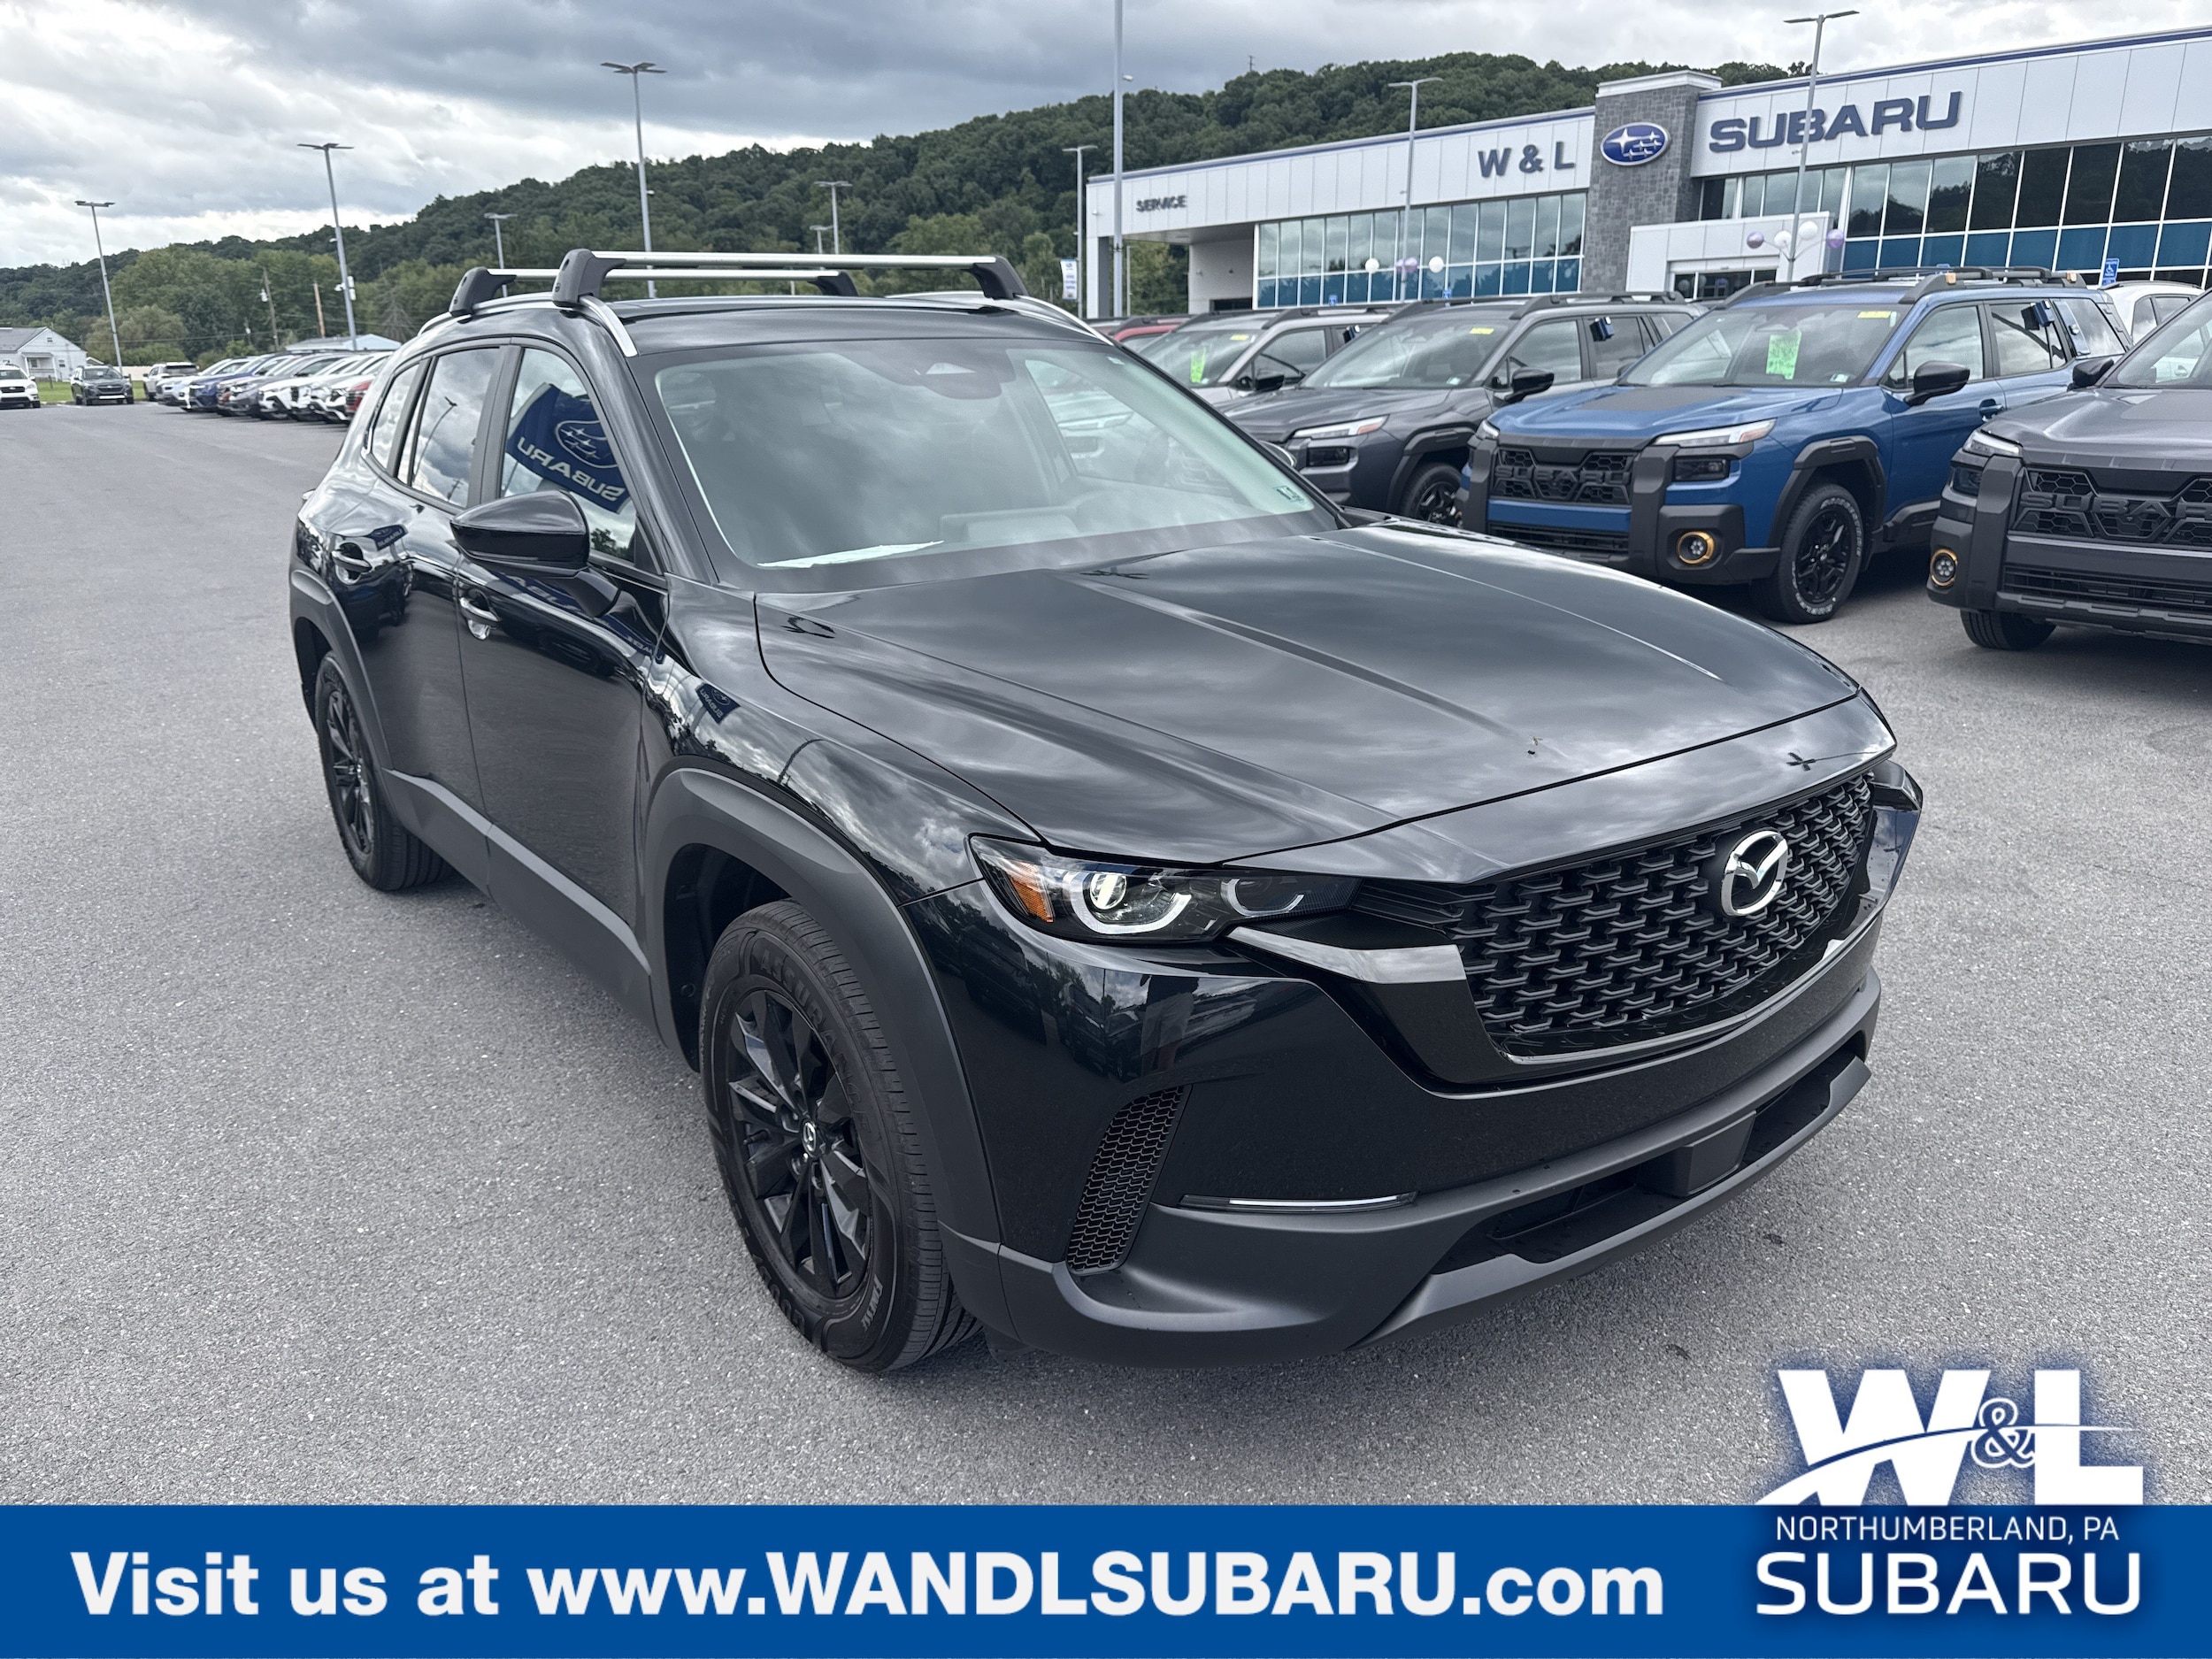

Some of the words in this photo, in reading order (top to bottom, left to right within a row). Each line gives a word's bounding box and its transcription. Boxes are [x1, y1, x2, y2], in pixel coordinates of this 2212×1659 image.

[1709, 91, 1962, 153] SUBARU
[1478, 148, 1512, 178] W
[1518, 144, 1544, 173] &
[1555, 142, 1575, 169] L
[1136, 196, 1187, 212] SERVICE
[1495, 465, 1632, 484] SUBARU
[2020, 491, 2212, 520] SUBAR
